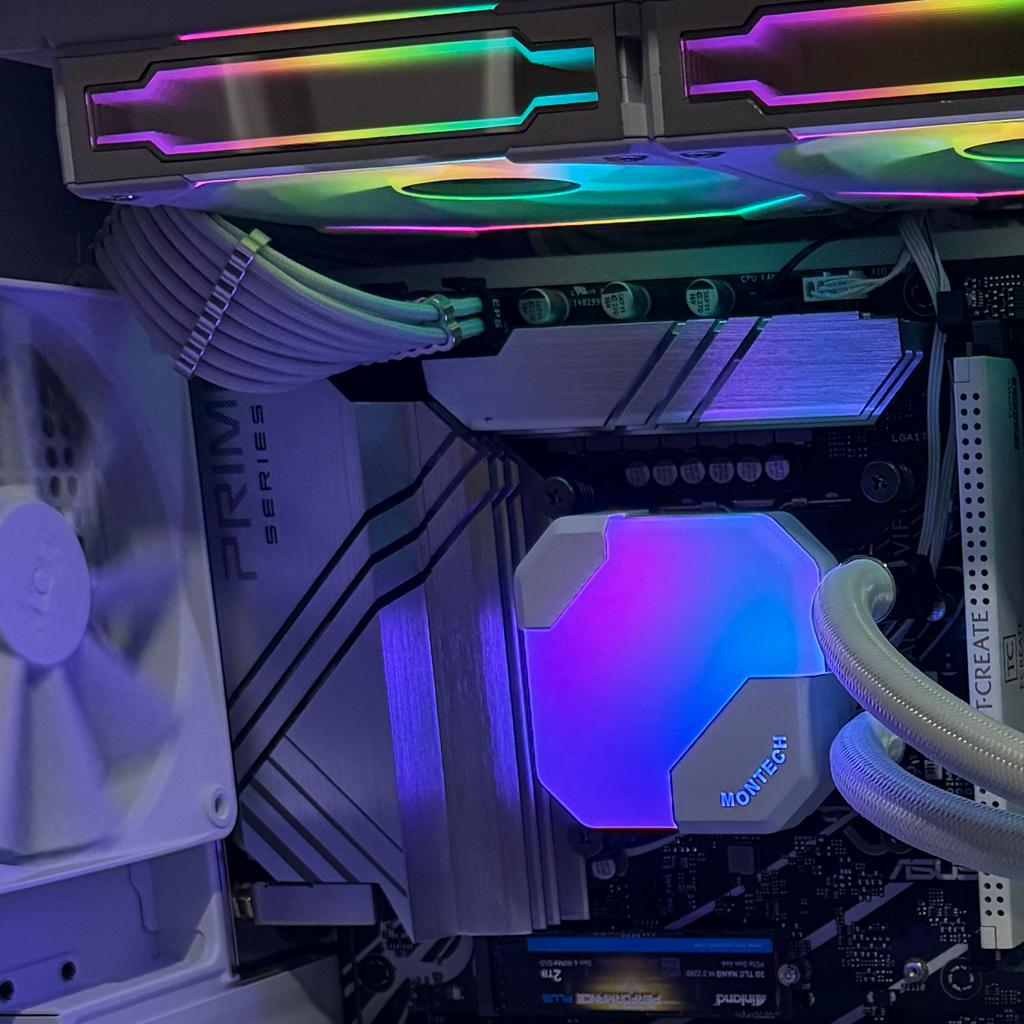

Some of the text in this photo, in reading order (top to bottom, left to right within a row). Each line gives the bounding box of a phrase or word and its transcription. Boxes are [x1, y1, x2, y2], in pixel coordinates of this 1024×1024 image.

[203, 397, 258, 582] PRIM
[251, 404, 279, 544] SERIES
[1005, 639, 1016, 679] TC
[720, 735, 788, 808] MONTECH
[540, 968, 562, 982] 2TB
[716, 969, 738, 978] NAND
[575, 992, 662, 1005] PERFORMANCE
